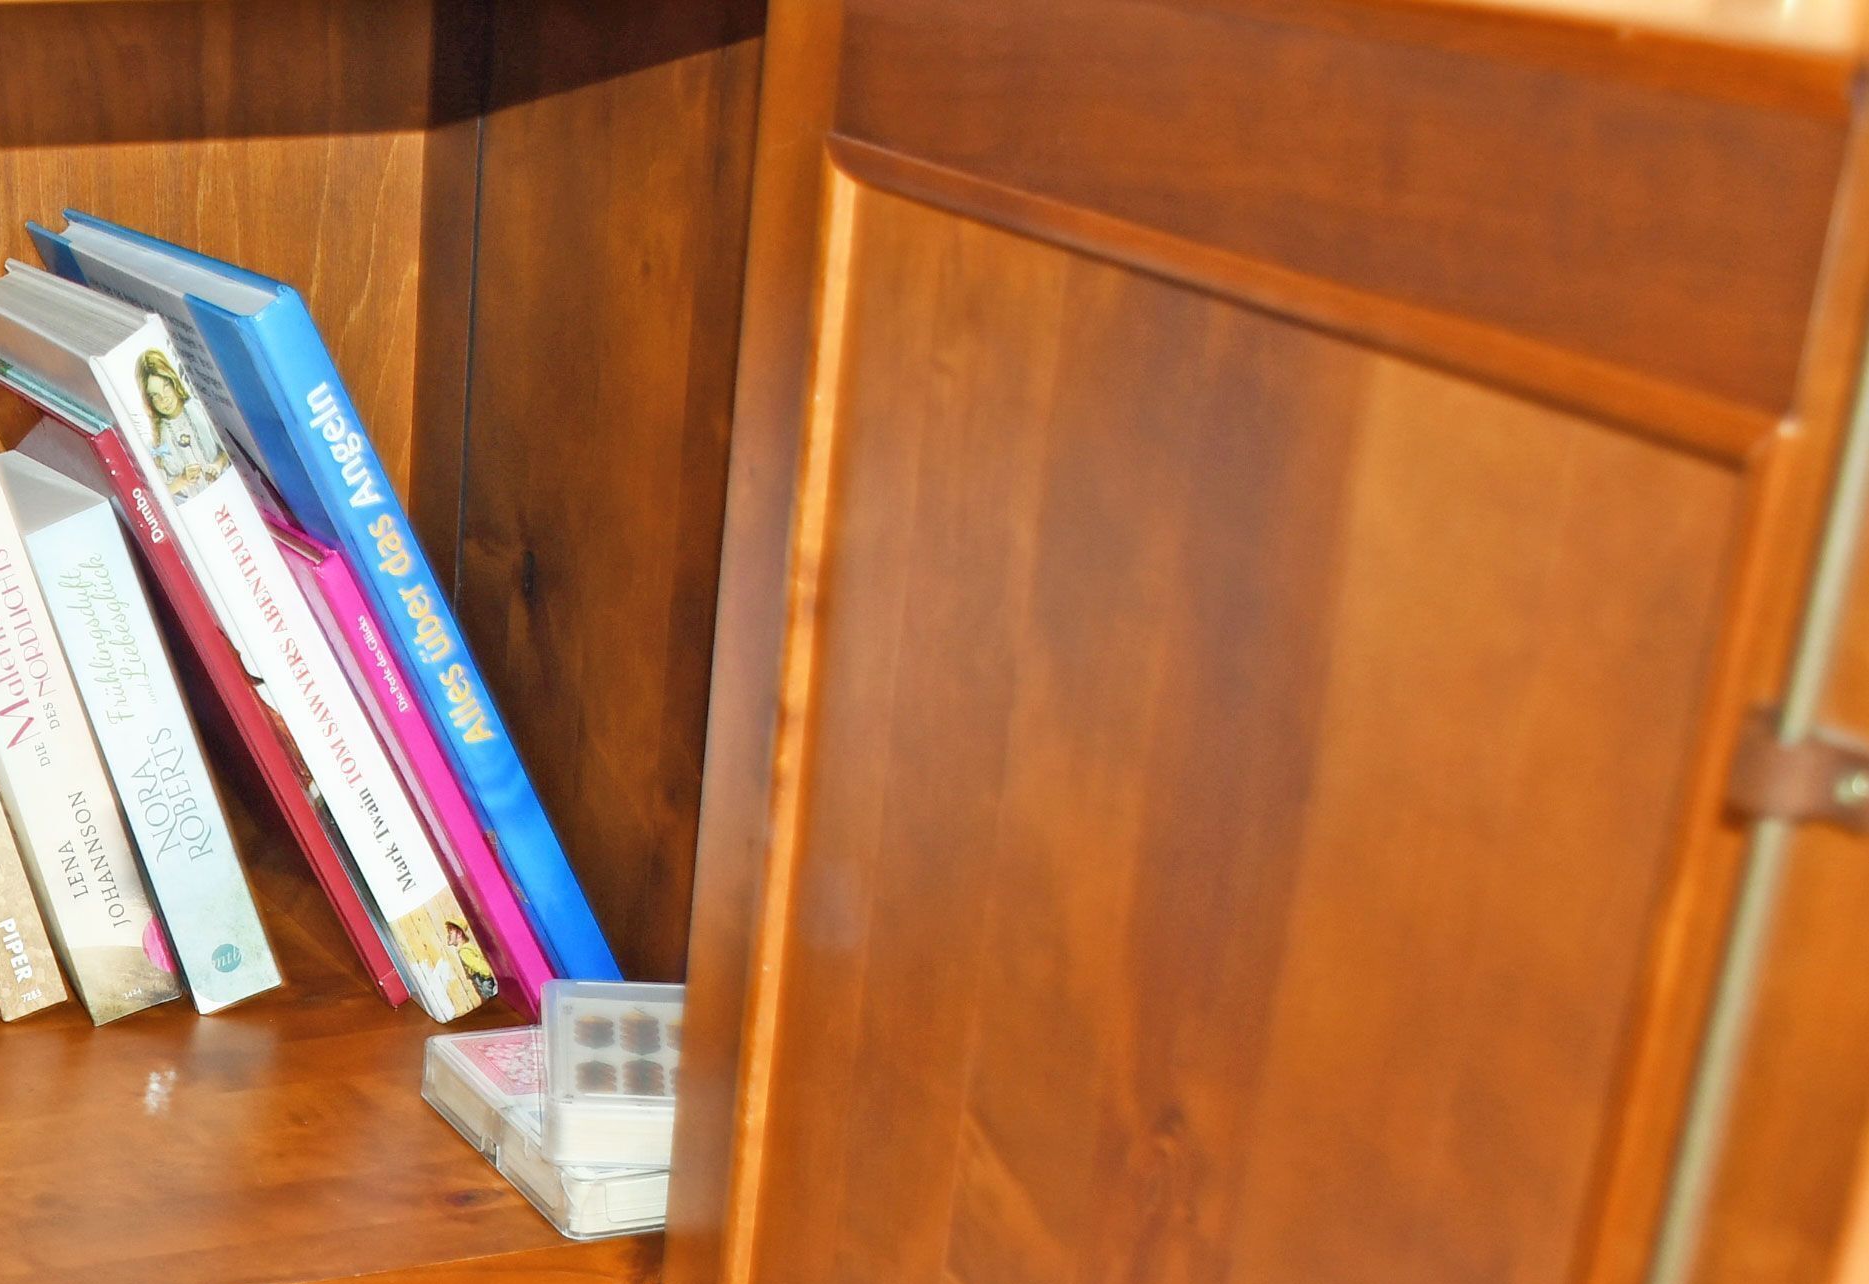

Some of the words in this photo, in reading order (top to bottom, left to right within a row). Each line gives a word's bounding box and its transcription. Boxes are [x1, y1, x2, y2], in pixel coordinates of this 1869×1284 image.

[306, 380, 382, 509] Angeln
[132, 487, 165, 543] Dumbo
[367, 513, 412, 576] das
[213, 502, 289, 634] ABENTEUER
[397, 583, 452, 664] über
[43, 702, 61, 731] DES
[281, 636, 340, 739] SAWYERS
[395, 692, 409, 713] Die
[438, 661, 495, 746] Alles
[34, 740, 52, 768] DIE
[330, 736, 365, 790] TOM
[131, 757, 181, 864] NORA
[146, 726, 214, 863] ROBERTS
[358, 785, 392, 843] Twain
[57, 840, 90, 900] LENA
[67, 789, 132, 929] JOHANNSON
[385, 843, 418, 894] Mark
